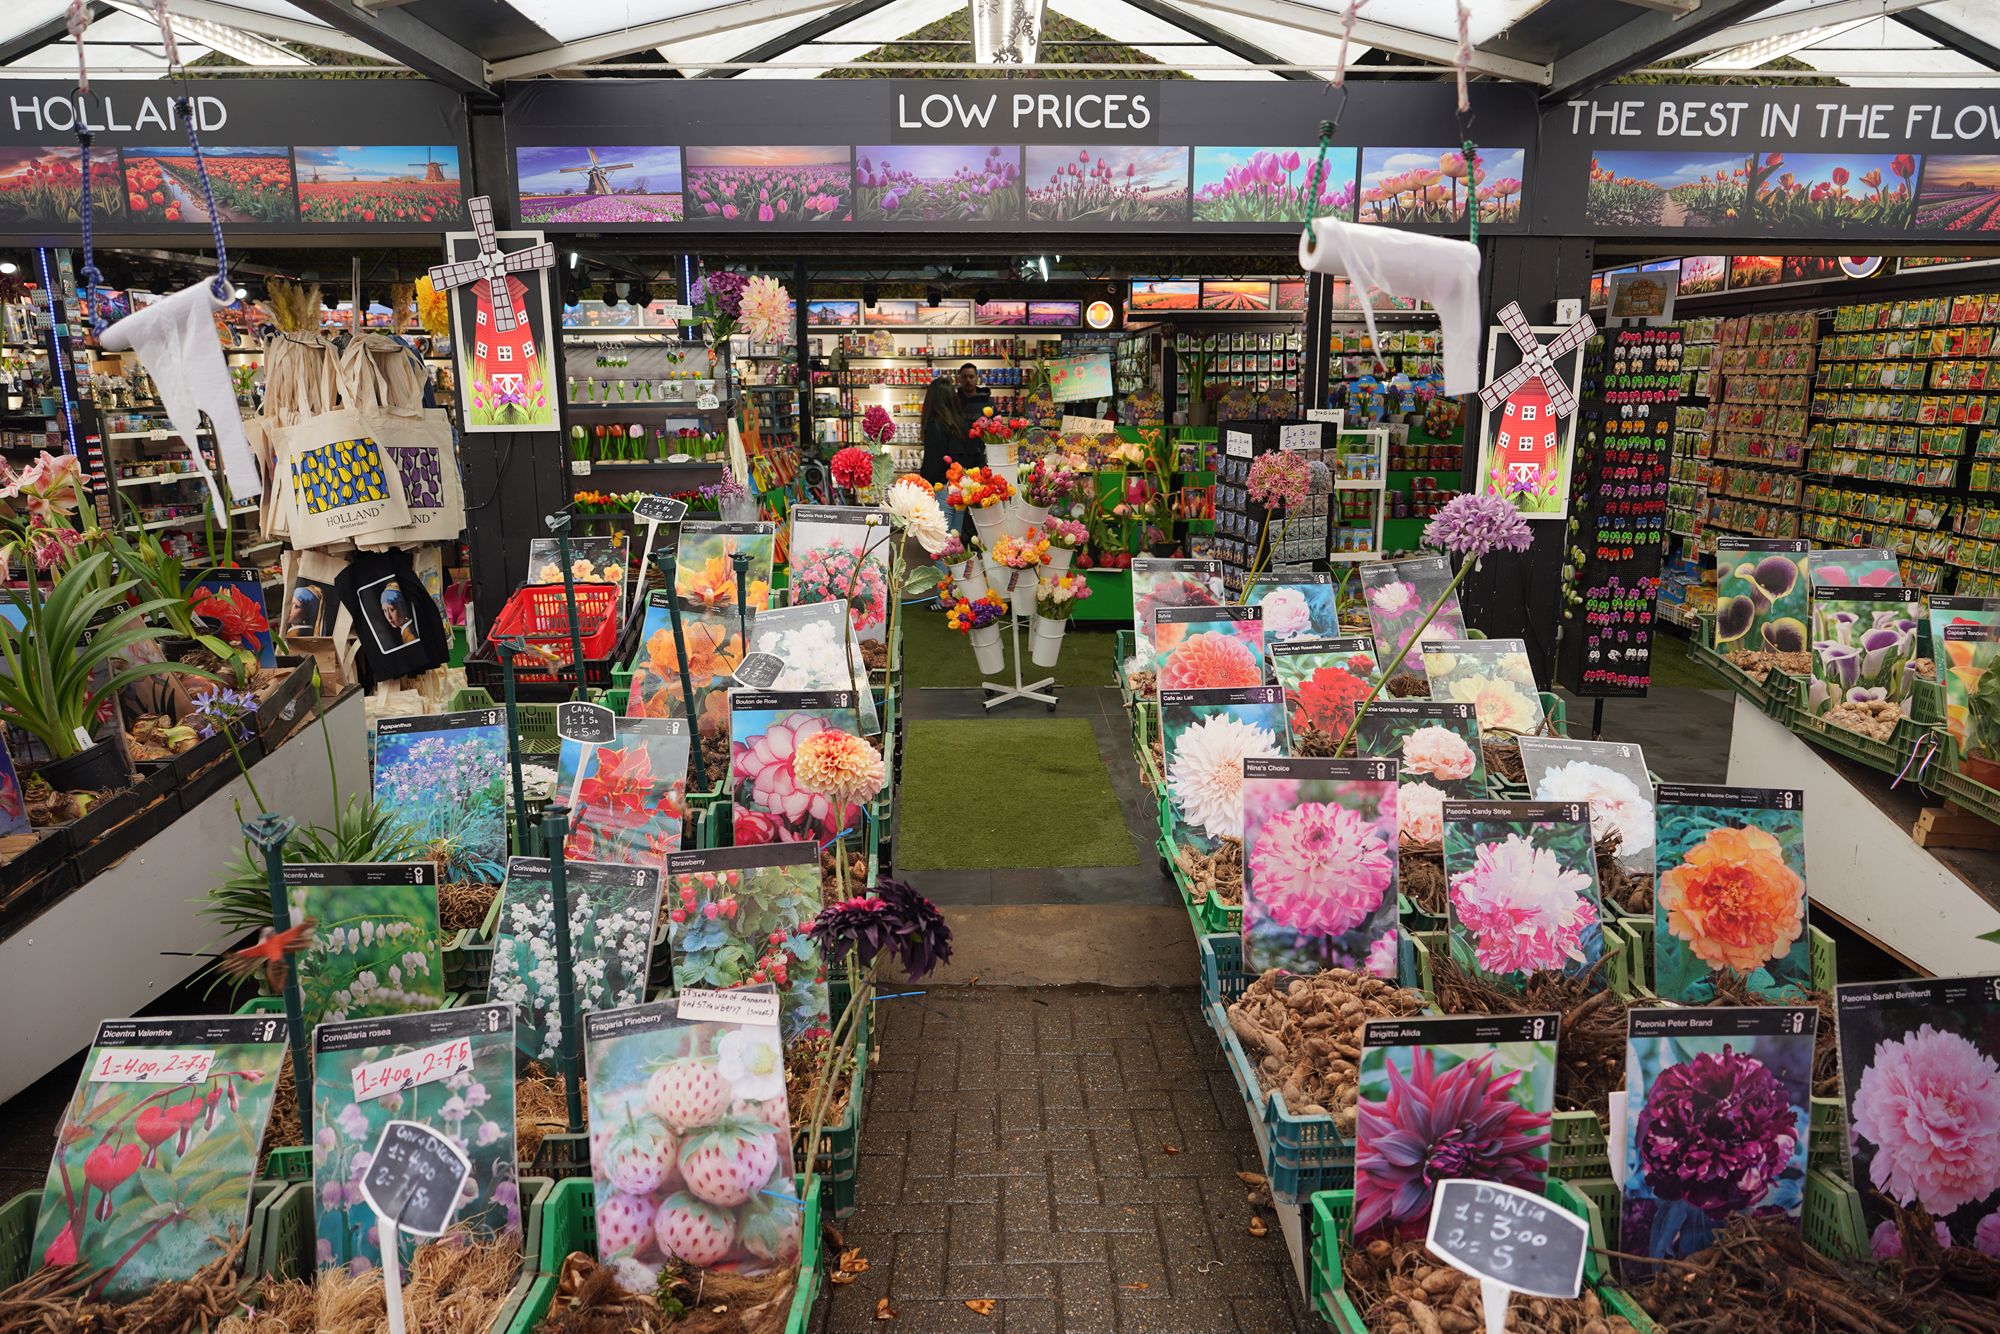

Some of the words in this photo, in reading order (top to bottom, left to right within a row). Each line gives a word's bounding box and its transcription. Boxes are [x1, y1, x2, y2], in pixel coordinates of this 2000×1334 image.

[10, 95, 228, 132] HOLLAND
[898, 93, 997, 129] LOW
[1012, 93, 1152, 130] PRICES
[1567, 100, 1645, 136] THE
[1656, 101, 1749, 138] BEST
[1760, 103, 1801, 138] IN
[1815, 103, 1894, 139] THE
[325, 506, 381, 528] HOLLAND
[380, 722, 412, 731] Agapanthus
[1246, 764, 1267, 772] Nina's
[1267, 764, 1291, 773] Choice
[1472, 808, 1492, 817] Candy
[1493, 808, 1512, 816] Stripe
[671, 858, 706, 868] Strawberry
[1842, 994, 1871, 1003] Paeonia
[1872, 992, 1894, 1001] Sarah
[1895, 989, 1932, 999] Bernhardt
[590, 1019, 624, 1033] Fragaria
[624, 1012, 662, 1027] Pineberry
[1634, 1019, 1666, 1029] Paeonia
[1667, 1018, 1688, 1028] Peter
[1689, 1018, 1713, 1027] Brand
[102, 1029, 136, 1038] Dicentra
[137, 1028, 173, 1037] Valentine
[322, 1030, 367, 1043] Convallaria
[368, 1028, 392, 1038] rosea
[1369, 1030, 1399, 1040] Brigitta
[1400, 1028, 1421, 1037] Alida
[1489, 1213, 1549, 1248] 3.00
